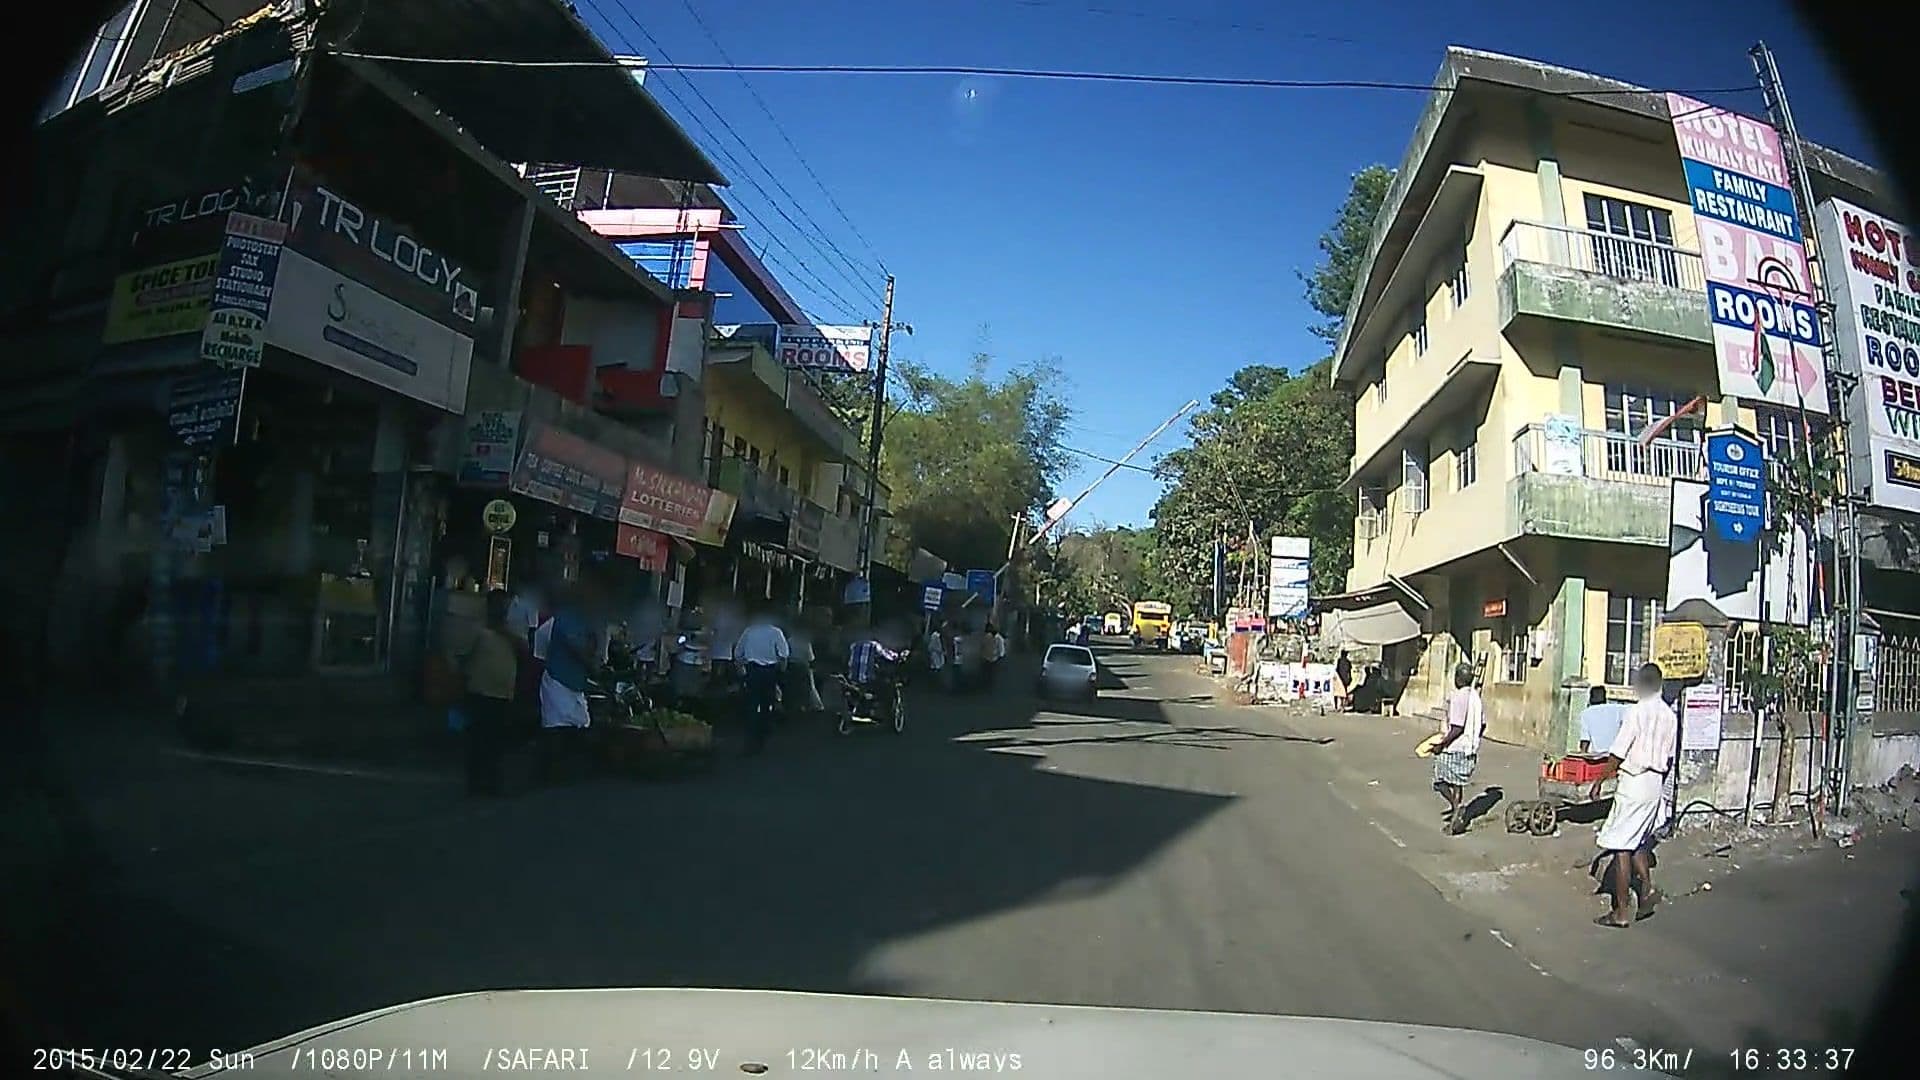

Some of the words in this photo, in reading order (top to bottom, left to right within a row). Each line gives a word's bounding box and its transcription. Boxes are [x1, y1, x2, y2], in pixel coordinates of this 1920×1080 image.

[1679, 97, 1773, 156] HOTEL
[1713, 170, 1766, 203] FAMILY
[1745, 156, 1784, 184] GATE
[1695, 187, 1794, 237] RESTAURANT
[226, 236, 279, 256] PHOTOSTAT
[1703, 223, 1806, 294] BAR
[1714, 289, 1813, 339] ROOMS
[1874, 284, 1920, 317] FAMIL
[782, 348, 866, 368] ROOMS
[631, 490, 699, 520] LOTTERIES
